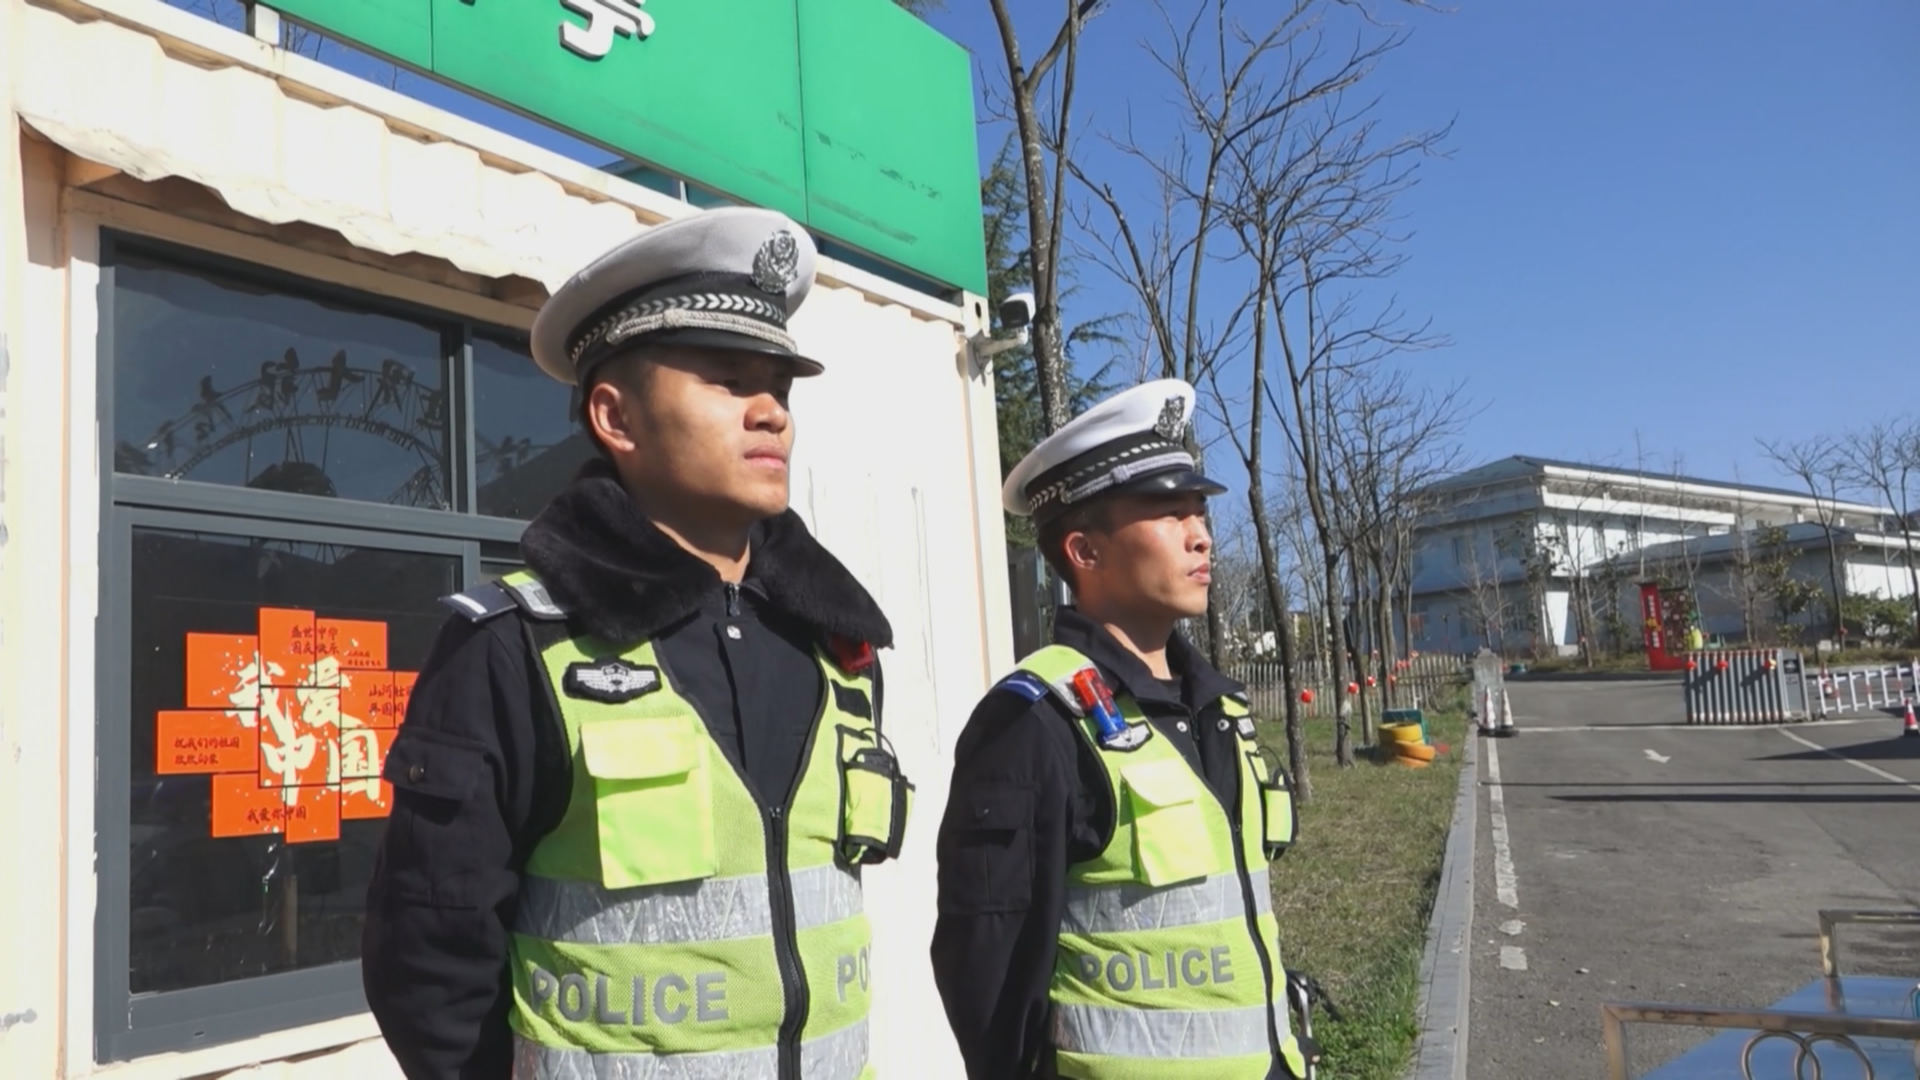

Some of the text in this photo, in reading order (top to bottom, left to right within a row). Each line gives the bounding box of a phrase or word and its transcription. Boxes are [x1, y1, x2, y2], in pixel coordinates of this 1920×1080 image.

[246, 804, 307, 825] 我爱你中国
[1080, 946, 1235, 992] POLICE
[531, 967, 730, 1026] POLICE
